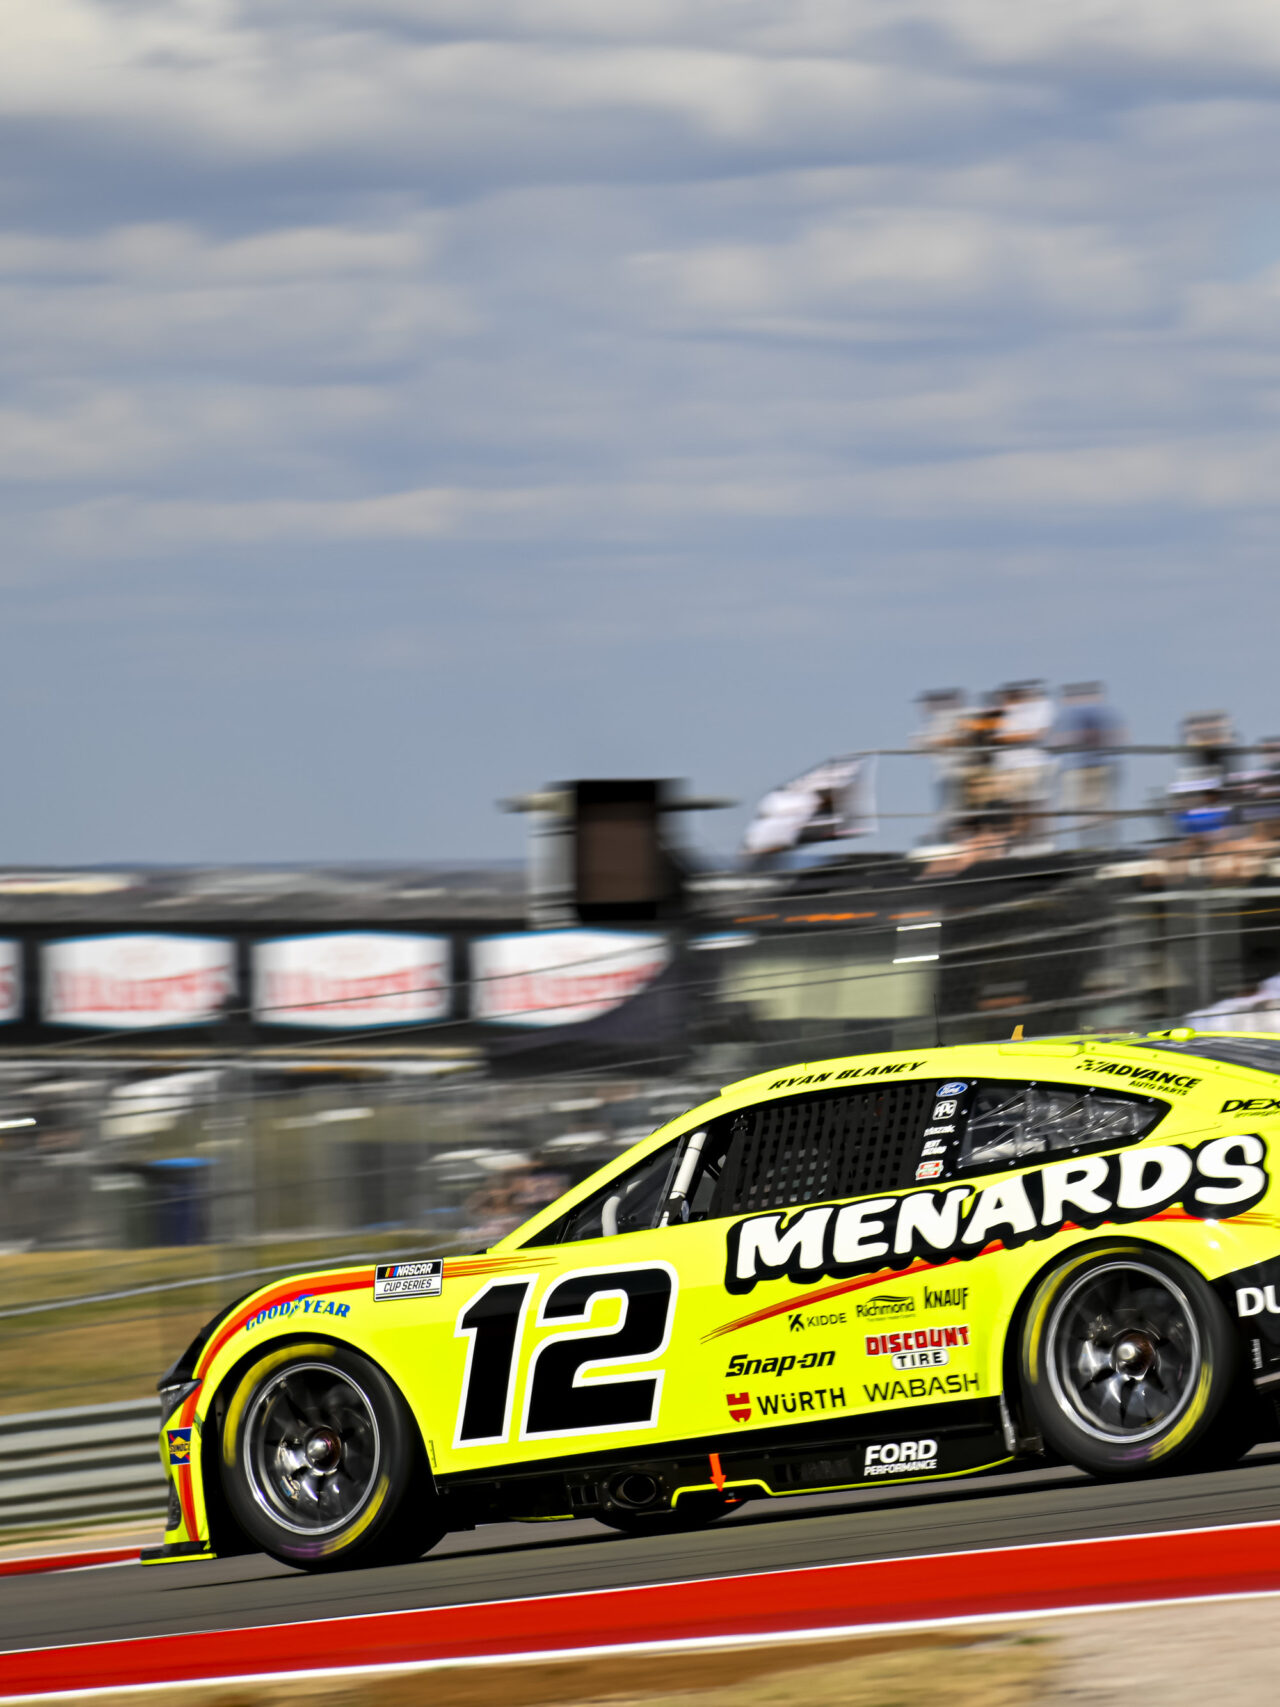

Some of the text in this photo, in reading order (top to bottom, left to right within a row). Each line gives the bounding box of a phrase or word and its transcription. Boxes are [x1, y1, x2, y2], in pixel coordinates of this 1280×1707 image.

[767, 1060, 928, 1091] RYAN BLANEY
[1099, 1063, 1203, 1089] ADVANCE
[1128, 1080, 1189, 1096] AUTO PARTS
[728, 1133, 1268, 1290] MENARDS
[396, 1262, 433, 1277] NASCAR
[383, 1278, 432, 1293] CUP SERIES
[856, 1296, 916, 1318] Richmond
[924, 1286, 969, 1311] KNAUF
[806, 1312, 847, 1328] KIDDE
[866, 1325, 970, 1355] DISCOUNT
[452, 1260, 679, 1449] 12
[725, 1350, 836, 1377] Snap-on
[897, 1351, 943, 1368] TIRE
[864, 1372, 980, 1402] WABASH
[864, 1439, 938, 1466] FORD
[863, 1459, 938, 1476] PERFORMANCE
